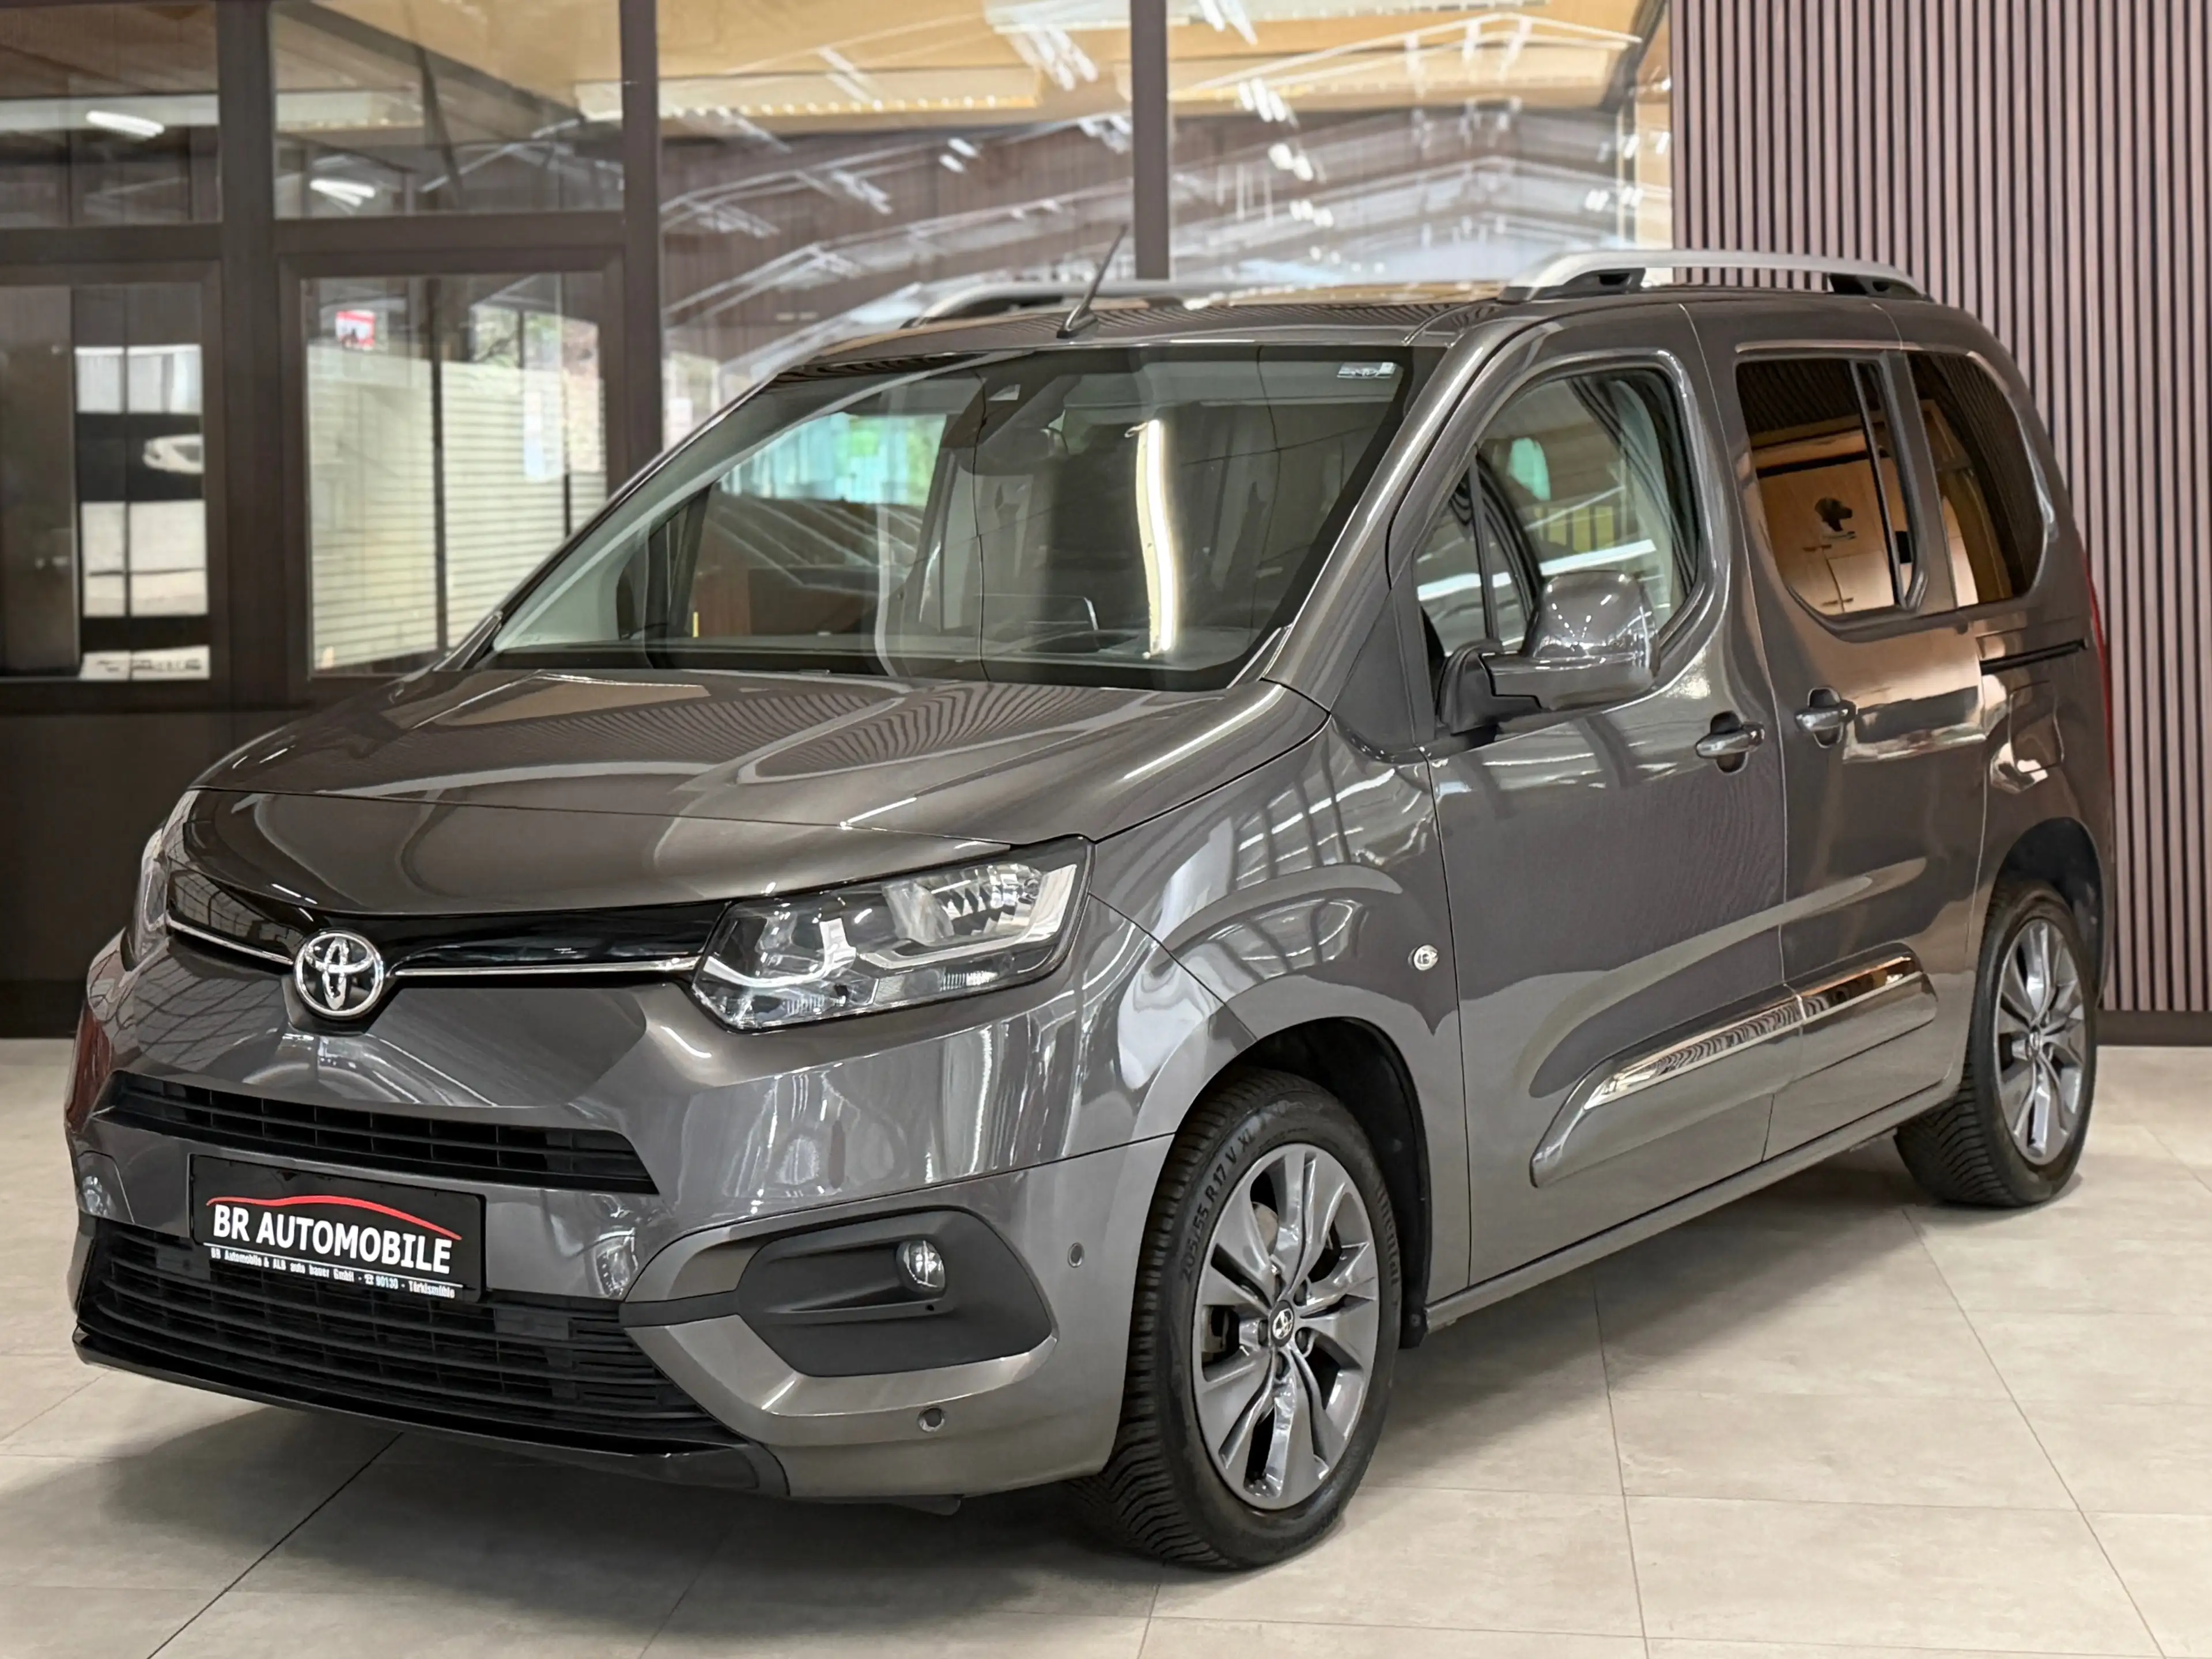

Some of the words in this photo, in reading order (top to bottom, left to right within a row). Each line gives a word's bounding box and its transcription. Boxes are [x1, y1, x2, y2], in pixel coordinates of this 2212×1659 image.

[1205, 1184, 1219, 1203] R
[1213, 1162, 1226, 1186] 17
[1225, 1145, 1237, 1165] V
[213, 1205, 250, 1241] BR
[256, 1212, 452, 1274] AUTOMOBILE
[333, 1268, 355, 1282] GmbH
